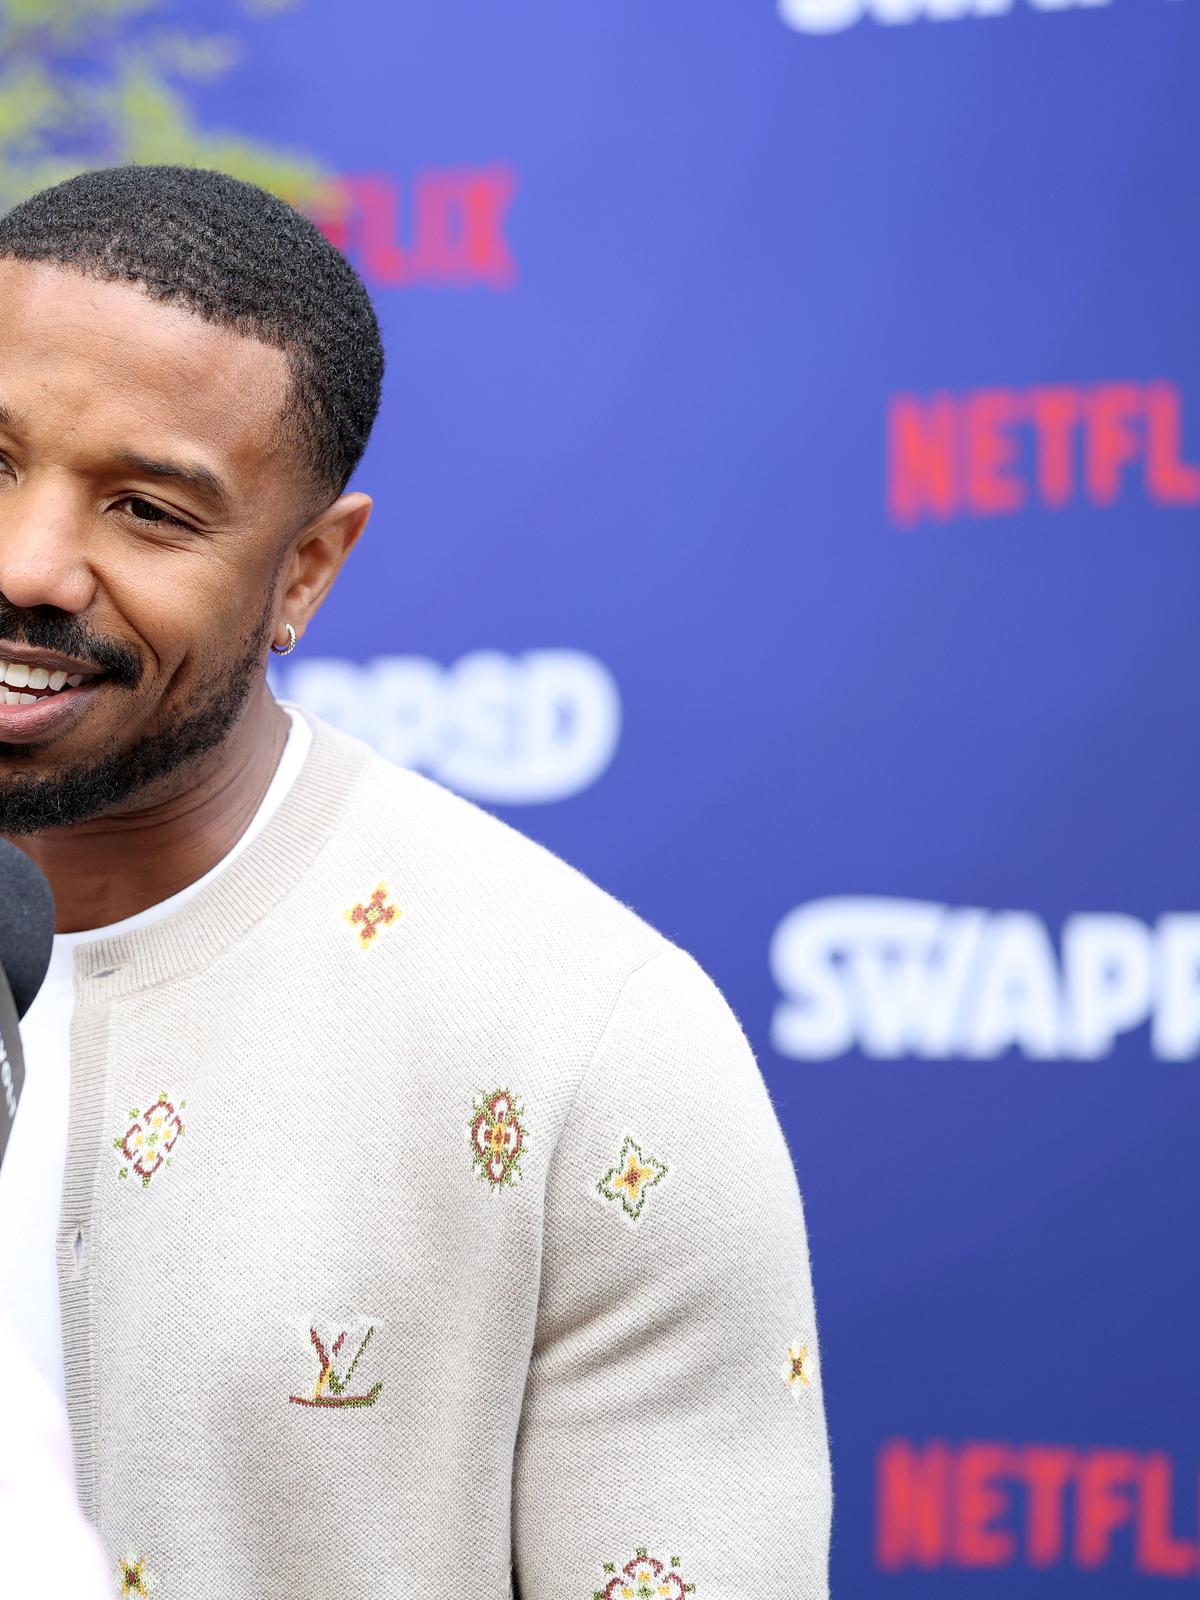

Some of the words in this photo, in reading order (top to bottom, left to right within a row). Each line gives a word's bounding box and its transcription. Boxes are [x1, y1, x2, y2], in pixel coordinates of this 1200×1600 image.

[317, 163, 517, 291] LIX
[886, 379, 1200, 529] NETFL
[875, 1437, 1200, 1577] NETFL
